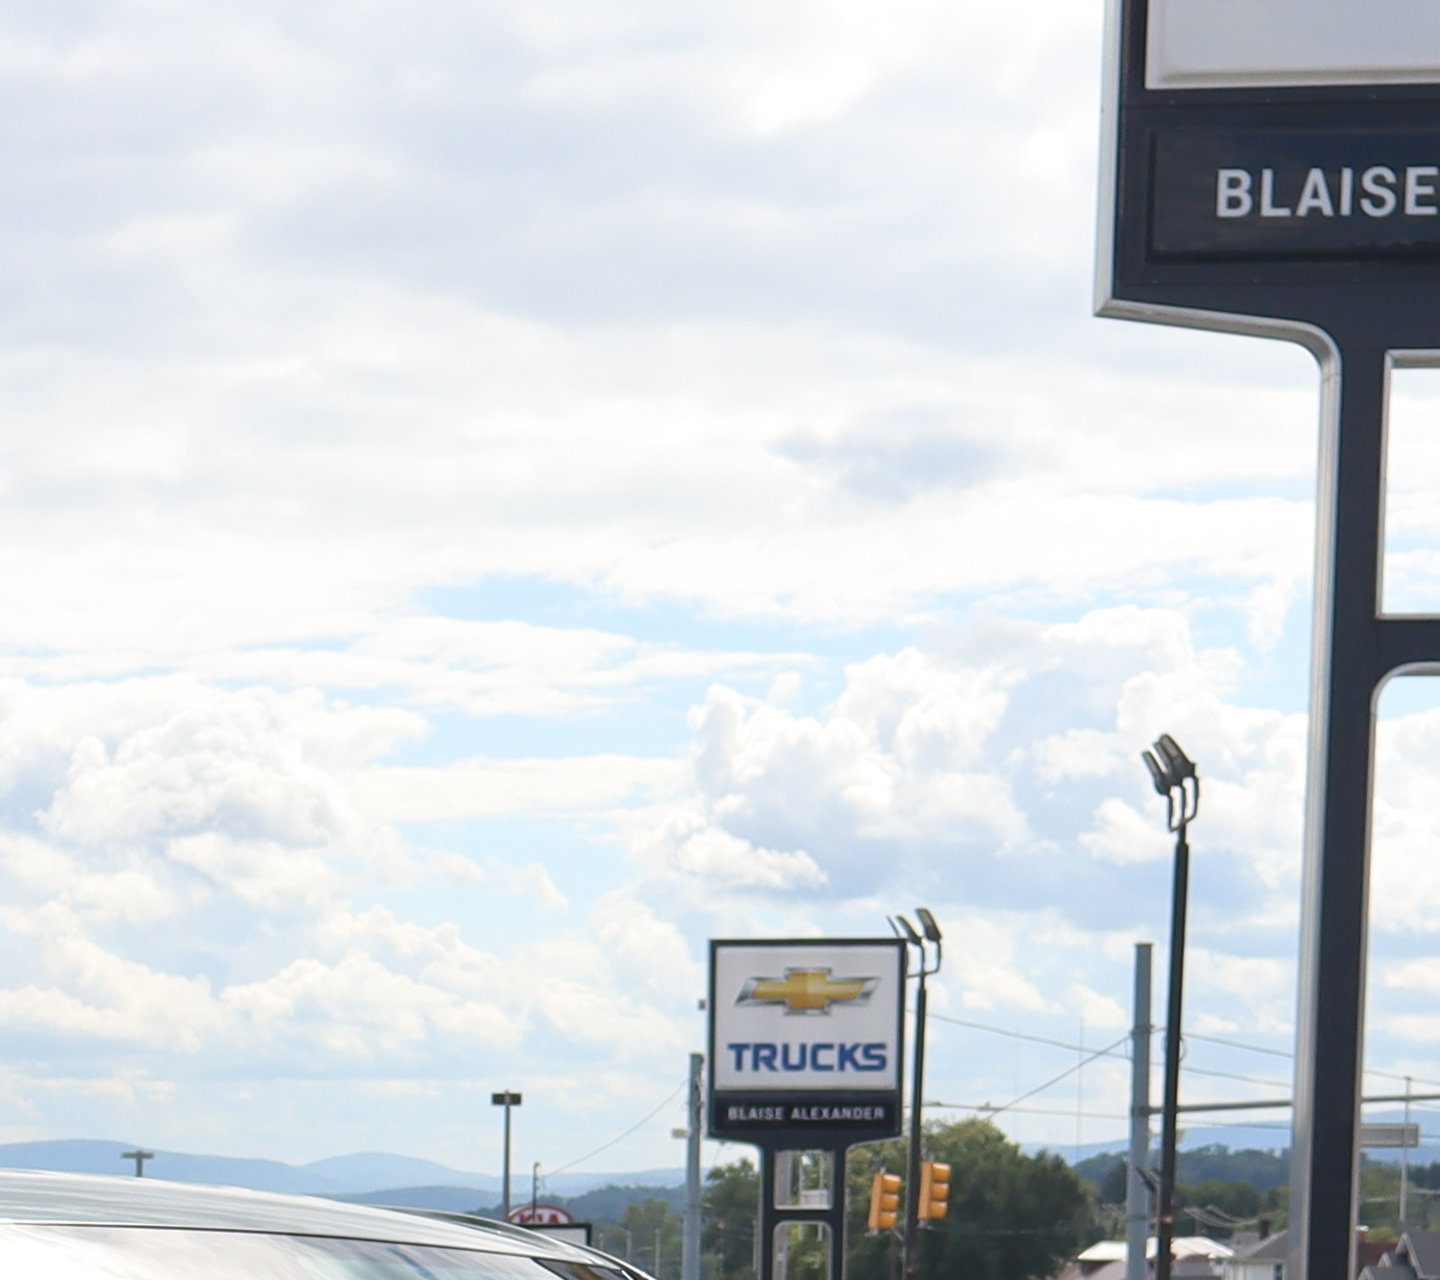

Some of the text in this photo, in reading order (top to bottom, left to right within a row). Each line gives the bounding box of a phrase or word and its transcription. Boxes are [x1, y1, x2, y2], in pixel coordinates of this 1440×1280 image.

[1216, 166, 1440, 218] BLAISE
[727, 1042, 886, 1072] TRUCKS
[728, 1105, 885, 1120] BLAISE ALEXANDER
